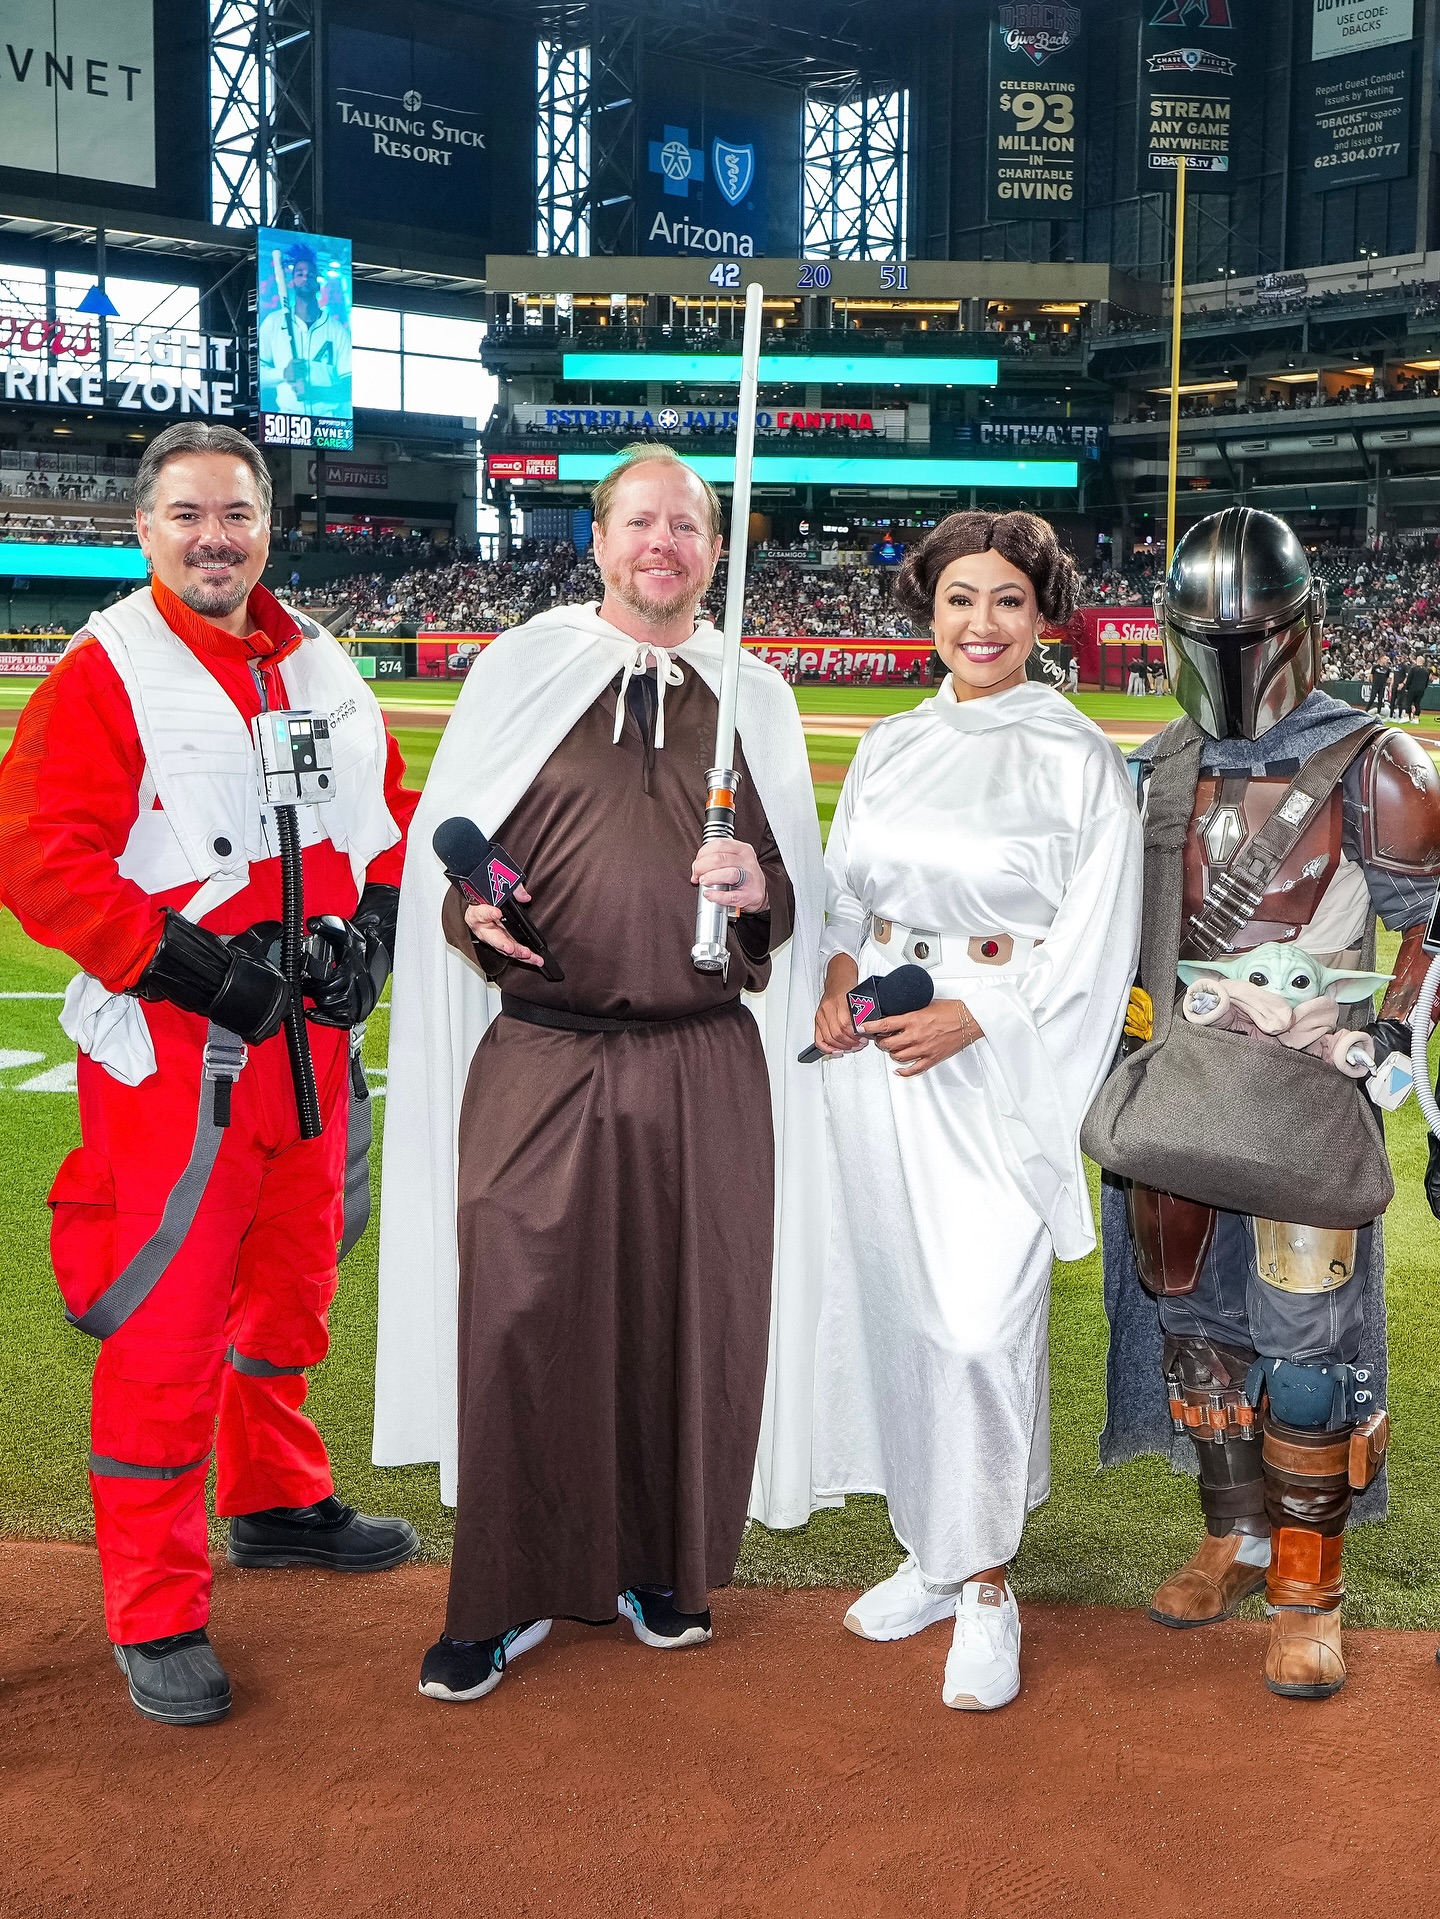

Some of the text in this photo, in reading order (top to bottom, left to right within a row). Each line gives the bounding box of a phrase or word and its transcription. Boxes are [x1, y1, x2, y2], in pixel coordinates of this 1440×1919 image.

[1337, 13, 1355, 25] USE
[1357, 6, 1388, 21] CODE:
[1342, 20, 1381, 36] DBACKS
[1006, 29, 1069, 51] Give Back
[1203, 58, 1227, 67] FIELD
[0, 44, 141, 101] VNET
[1000, 81, 1075, 92] CELEBRATING
[1315, 69, 1405, 96] Report Guest Conduct
[1352, 91, 1362, 101] by
[1364, 85, 1394, 98] Texting
[1000, 92, 1075, 134] $93
[1150, 101, 1231, 120] STREAM
[1149, 120, 1230, 136] ANY GAME
[1332, 121, 1383, 139] LOCATION
[998, 135, 1075, 152] MILLION
[1149, 136, 1230, 152] ANYWHERE
[1334, 134, 1384, 151] and issue to
[1028, 155, 1043, 166] IN
[1314, 142, 1401, 168] 623.304.0777
[998, 168, 1074, 181] CHARITABLE
[997, 181, 1074, 201] GIVING
[648, 211, 754, 258] Arizona
[708, 262, 741, 288] 42
[796, 263, 832, 289] 20
[878, 264, 909, 290] 51
[107, 326, 234, 371] LIGHT
[5, 363, 235, 417] RIKE ZONE
[545, 409, 654, 427] ESTRELLA
[777, 412, 874, 431] CANTINA
[313, 427, 351, 439] AVNET
[980, 423, 1099, 446] CUTWAER
[316, 437, 347, 448] CARES
[344, 472, 387, 485] FITNESS
[525, 465, 557, 475] METER
[1121, 622, 1158, 640] State
[0, 656, 23, 664] HIPS
[379, 660, 403, 673] 374
